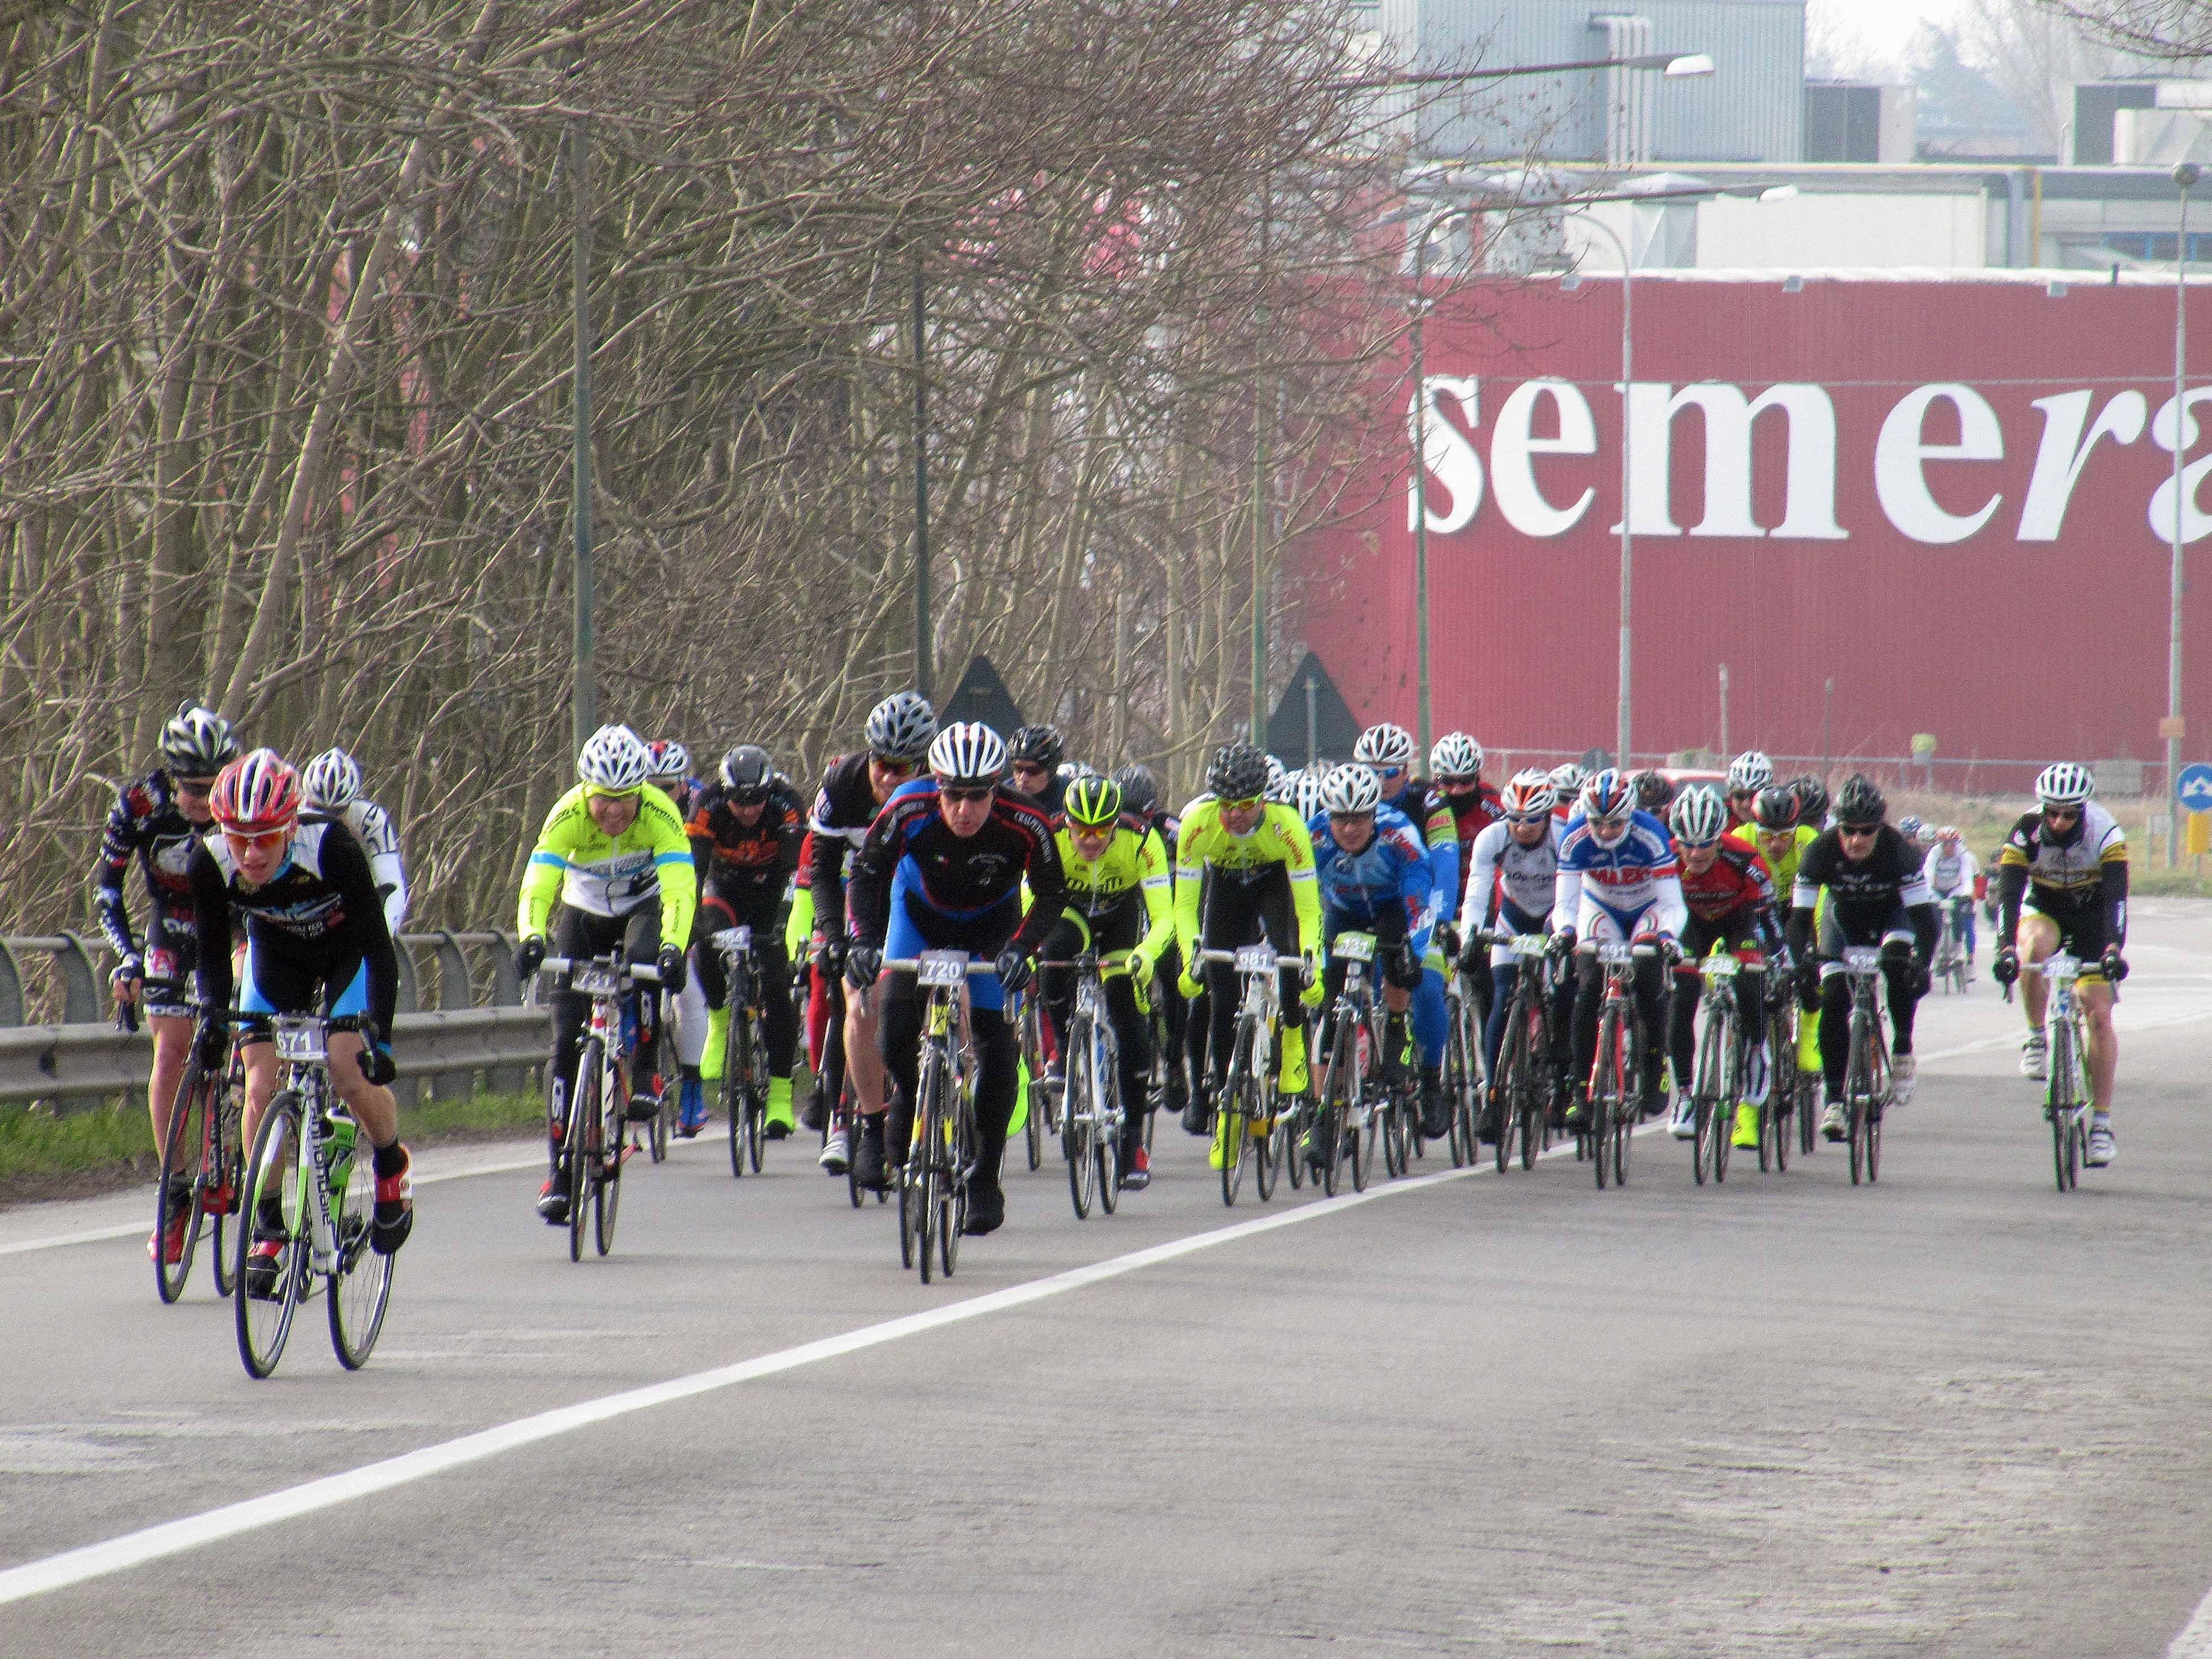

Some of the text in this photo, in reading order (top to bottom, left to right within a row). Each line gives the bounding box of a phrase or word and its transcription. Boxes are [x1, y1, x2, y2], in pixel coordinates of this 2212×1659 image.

[1407, 374, 2212, 545] semera
[925, 960, 960, 978] 720
[276, 1030, 312, 1052] 671
